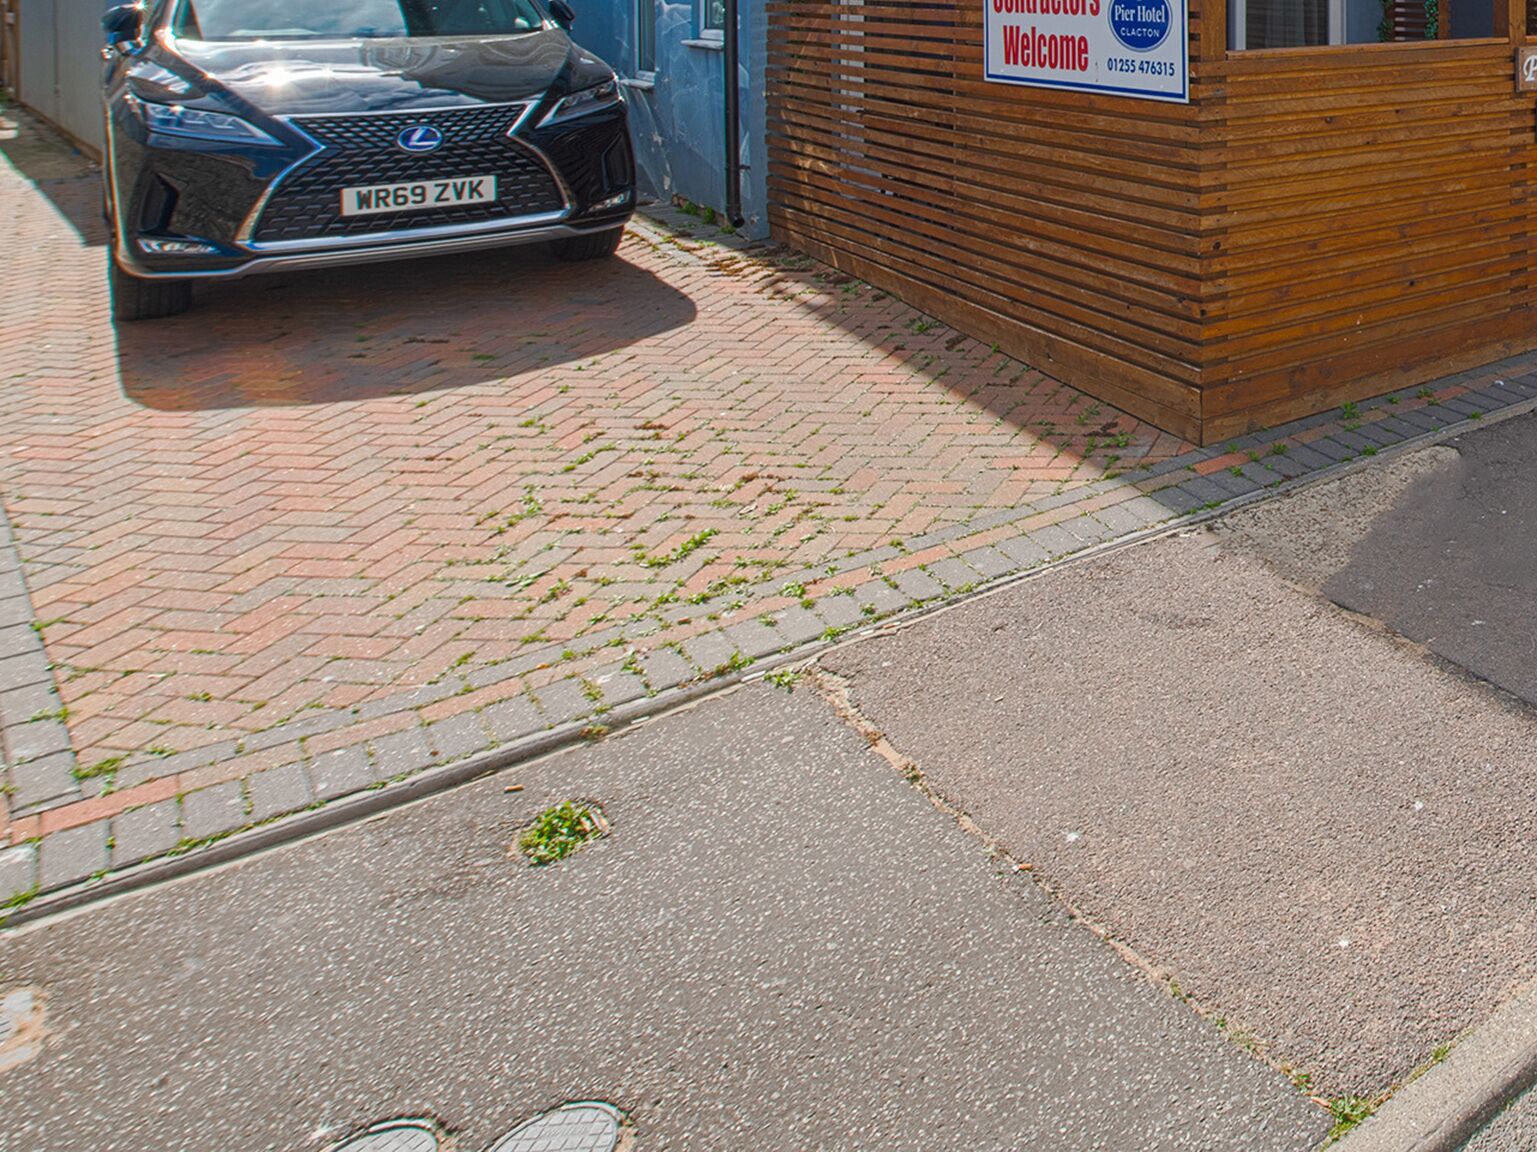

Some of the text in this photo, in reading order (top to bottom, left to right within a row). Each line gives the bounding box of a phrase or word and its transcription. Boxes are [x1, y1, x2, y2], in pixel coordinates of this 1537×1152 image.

[1114, 4, 1165, 24] Pier Hotel
[1120, 26, 1159, 38] CLACTON
[1003, 25, 1089, 72] Welcome
[1107, 57, 1175, 76] 01255 476315
[356, 179, 484, 210] WR69 ZVK
